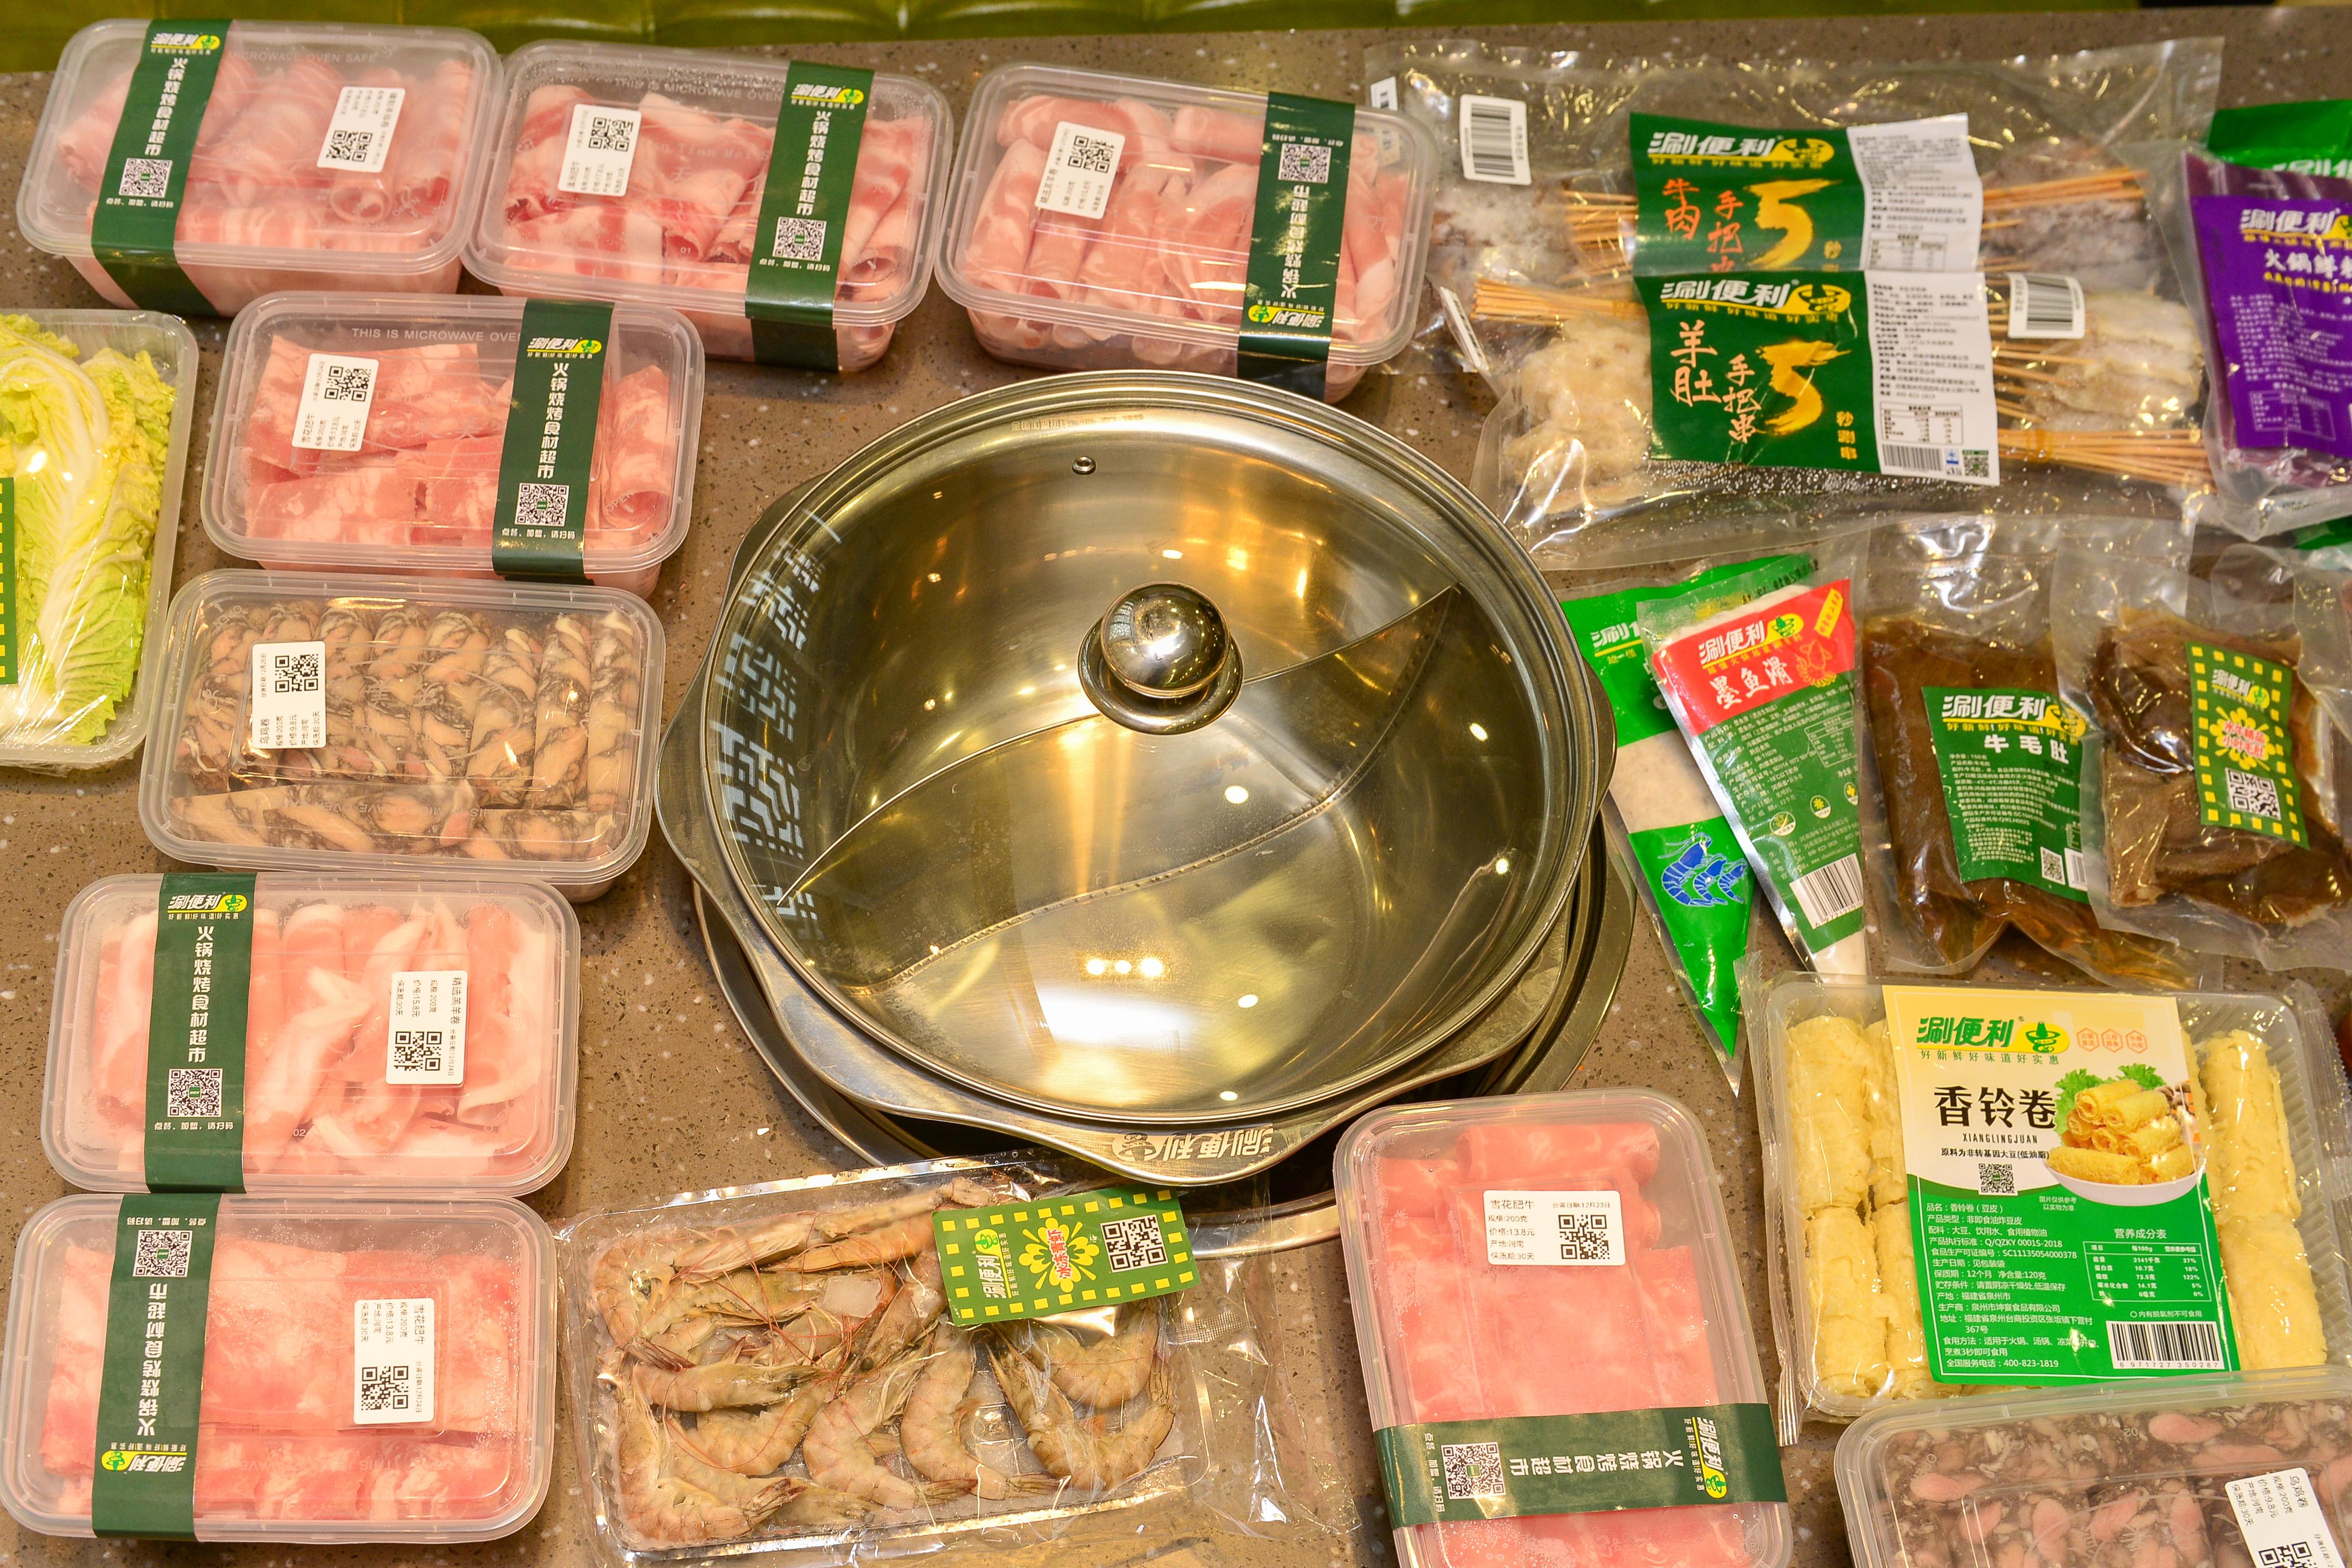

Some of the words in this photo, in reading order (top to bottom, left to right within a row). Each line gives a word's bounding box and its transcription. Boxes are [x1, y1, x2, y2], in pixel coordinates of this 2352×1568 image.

[144, 57, 189, 156] 火锅烧烤食材超市
[1647, 131, 1775, 156] 涮便利
[796, 111, 831, 215] 火锅烧烤食材超市
[1662, 178, 1701, 239] 牛肉
[1742, 179, 1843, 269] 5
[2239, 209, 2335, 234] 涮便利
[1660, 278, 1792, 309] 涮便利
[352, 328, 381, 338] THIS
[387, 329, 399, 338] IS
[405, 330, 484, 341] MICROWAVE
[490, 332, 521, 341] OVE
[528, 337, 578, 350] 涮便利
[1670, 320, 1722, 408] 羊肚
[1722, 353, 1761, 444] 手把串
[1755, 340, 1852, 437] 5
[537, 362, 569, 479] 火锅烧烤食材超市
[1698, 620, 1766, 665] 涮便利
[1710, 656, 1793, 709] 墨鱼滑
[1941, 695, 2046, 720] 涮便利
[1984, 734, 2069, 764] 牛毛肚
[167, 895, 222, 910] 涮便利
[188, 926, 214, 1063] 火锅烧烤食材超市
[1916, 1017, 2014, 1047] 涮便利
[1934, 1085, 2056, 1129] 香铃卷
[1162, 1128, 1273, 1161] 涮便利
[1963, 1132, 2038, 1144] XIANGLINGJUAN
[1490, 1199, 1535, 1209] 雪花肥牛
[1489, 1228, 1535, 1236] 价格:13.8元
[2114, 1229, 2167, 1239] 营养成分表
[975, 1255, 1007, 1300] 涮便利
[414, 1305, 425, 1344] 雪花肥牛
[1965, 1325, 1989, 1334] 367号
[137, 1282, 167, 1436] 火锅烧烤食材超市
[1697, 1417, 1723, 1472] 涮便利
[129, 1454, 187, 1472] 涮便利
[1509, 1449, 1684, 1477] 火锅烧烤食材超市
[2289, 1476, 2309, 1508] 乌鸡卷
